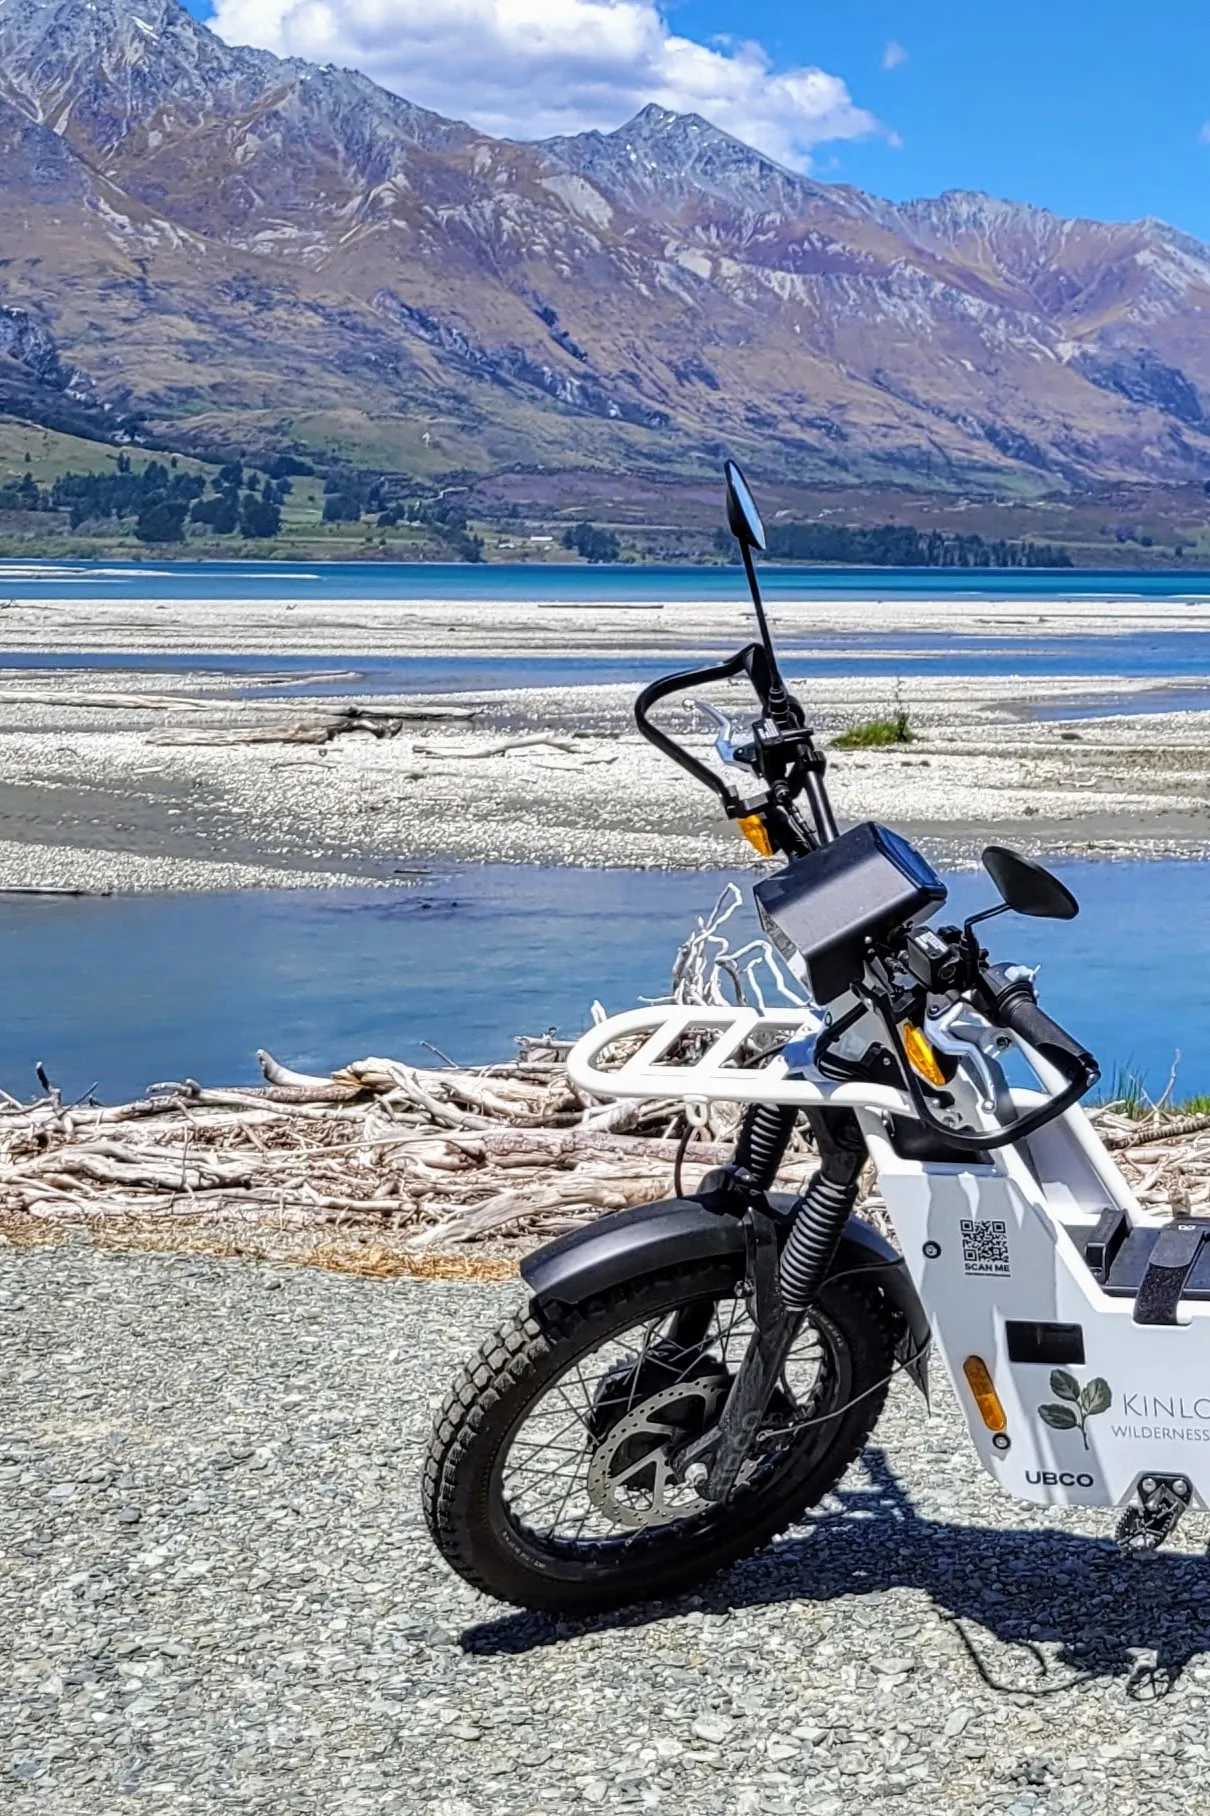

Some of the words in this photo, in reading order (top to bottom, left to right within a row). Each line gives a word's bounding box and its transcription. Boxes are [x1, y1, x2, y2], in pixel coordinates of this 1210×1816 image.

[965, 1262, 993, 1271] SCAN
[995, 1263, 1010, 1272] ME
[1111, 1424, 1210, 1442] WILDERNESS
[1025, 1470, 1095, 1488] UBCO
